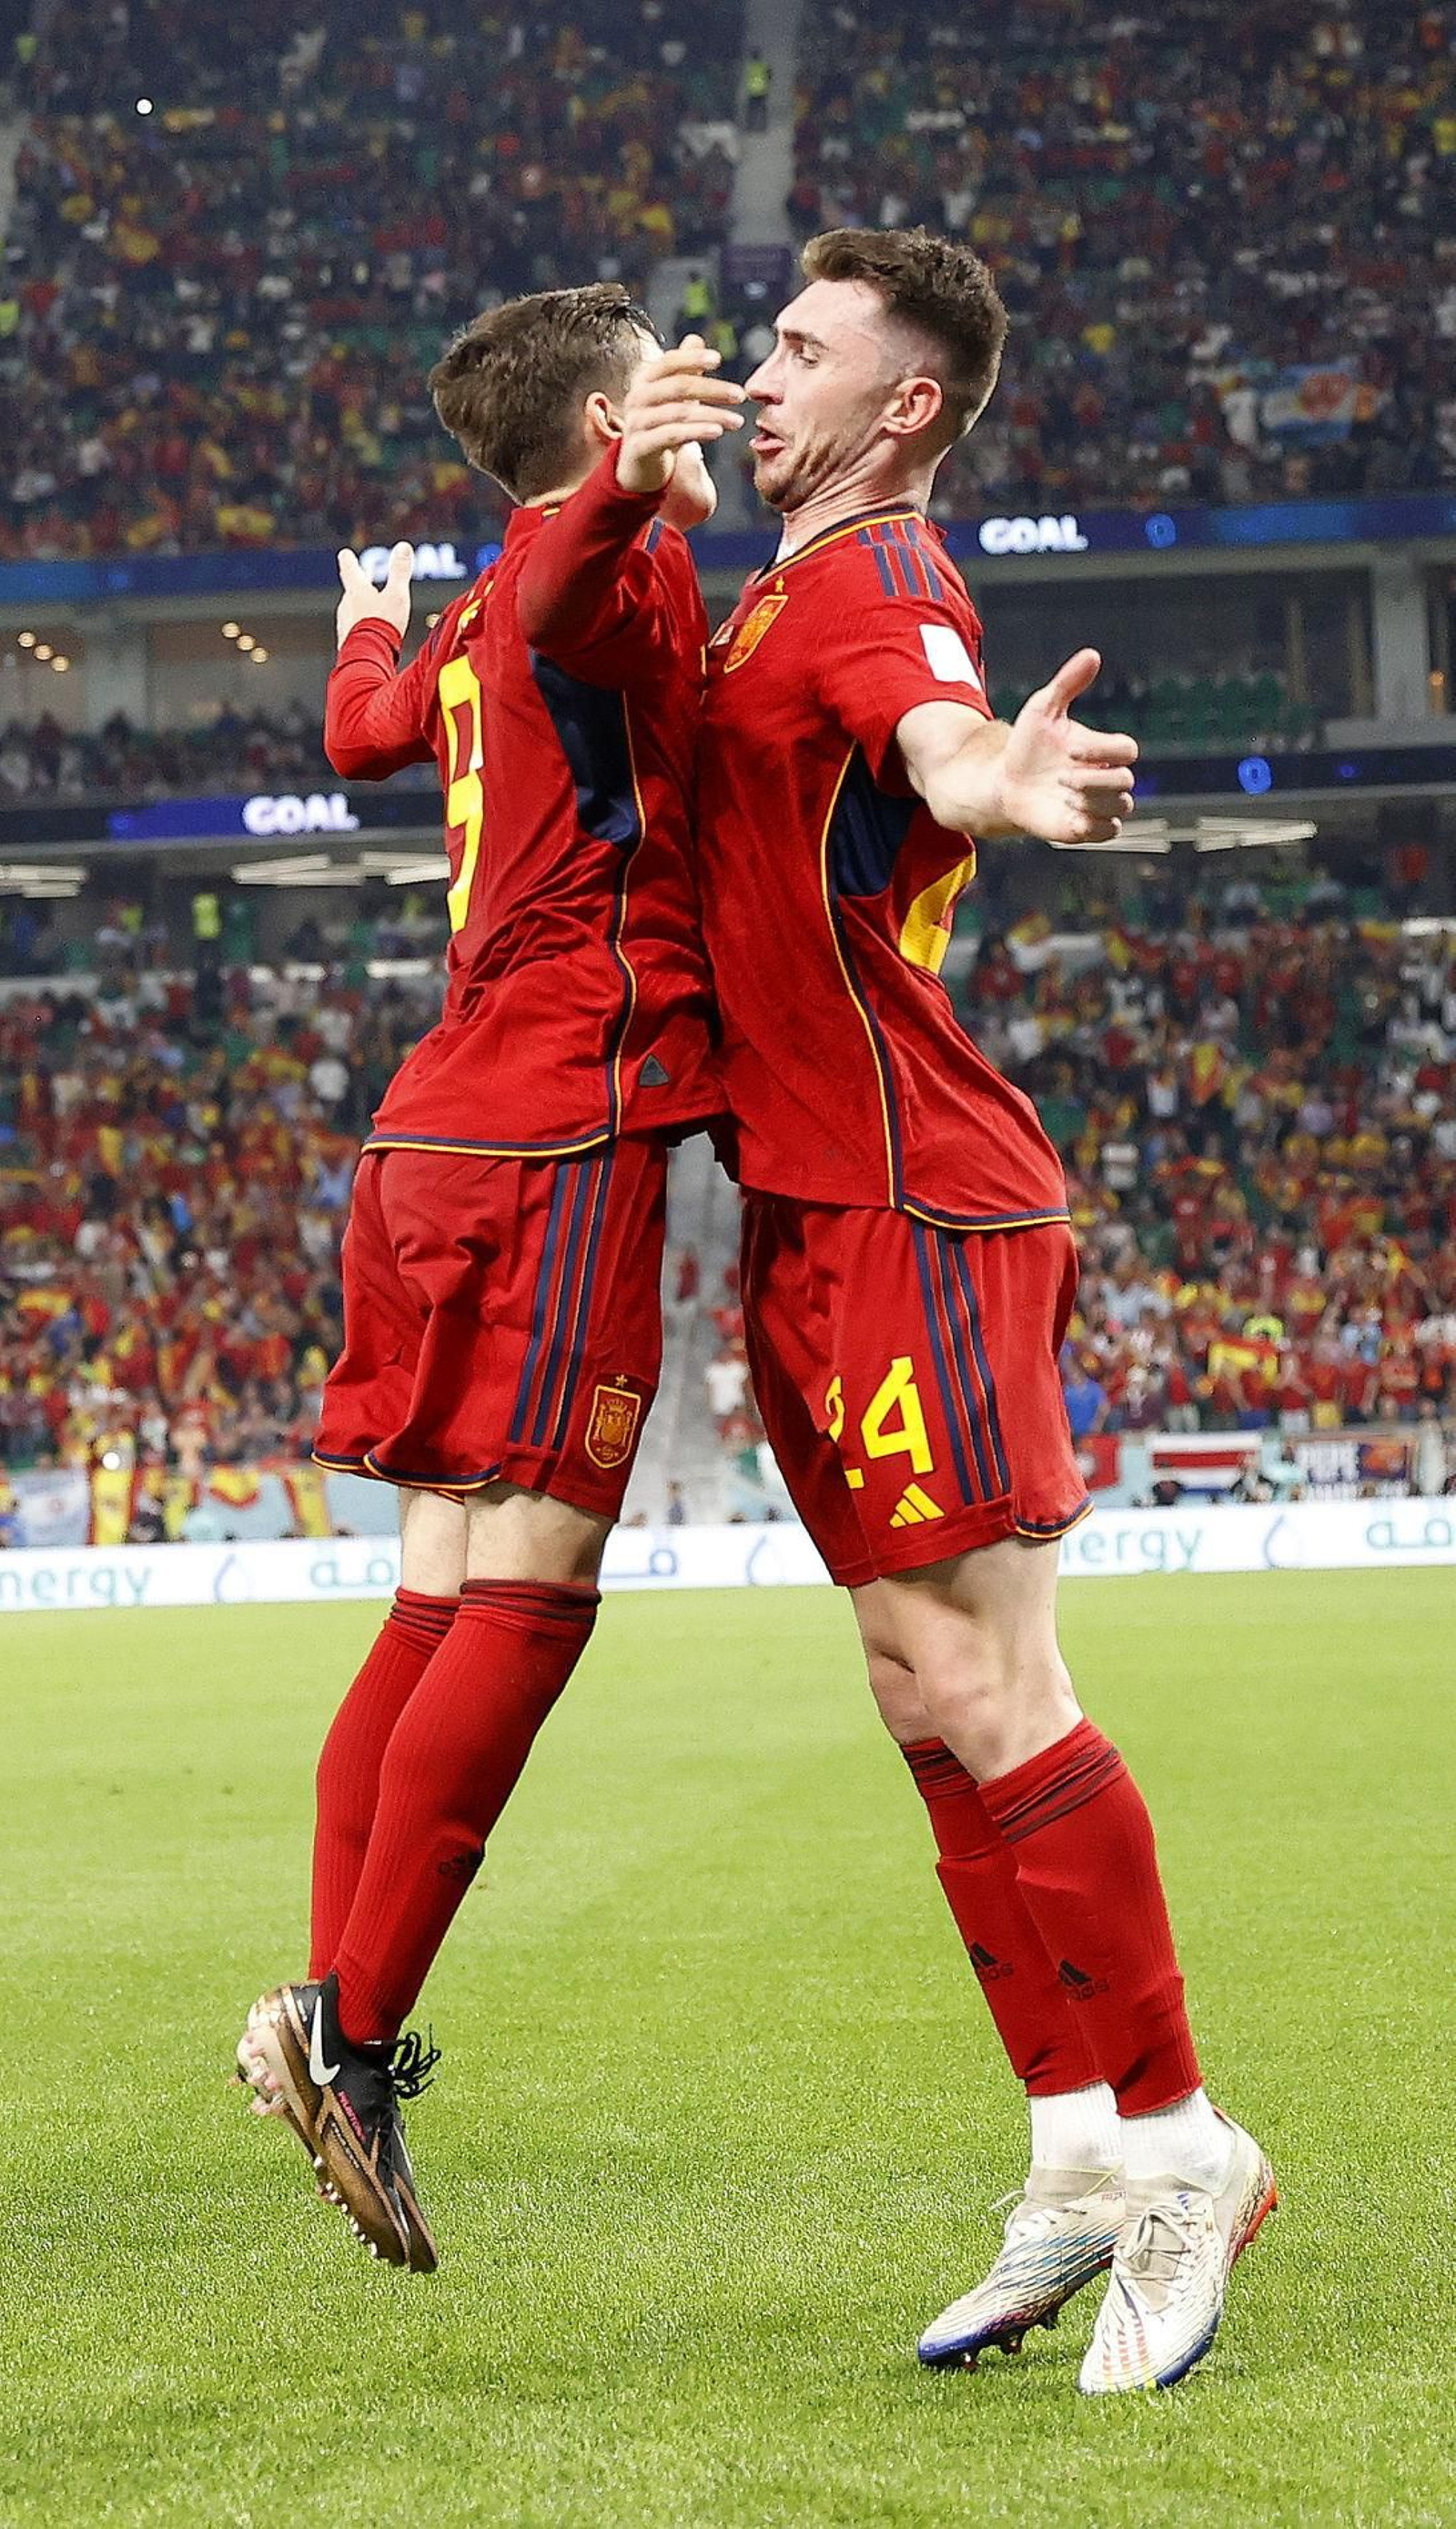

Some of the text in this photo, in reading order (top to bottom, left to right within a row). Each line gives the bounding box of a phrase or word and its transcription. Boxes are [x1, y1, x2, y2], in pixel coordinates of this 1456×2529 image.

[979, 515, 1088, 555] GOAL
[359, 542, 467, 582] GAL
[242, 793, 359, 835] GOAL
[438, 654, 484, 934] 9
[825, 1356, 935, 1490] 24
